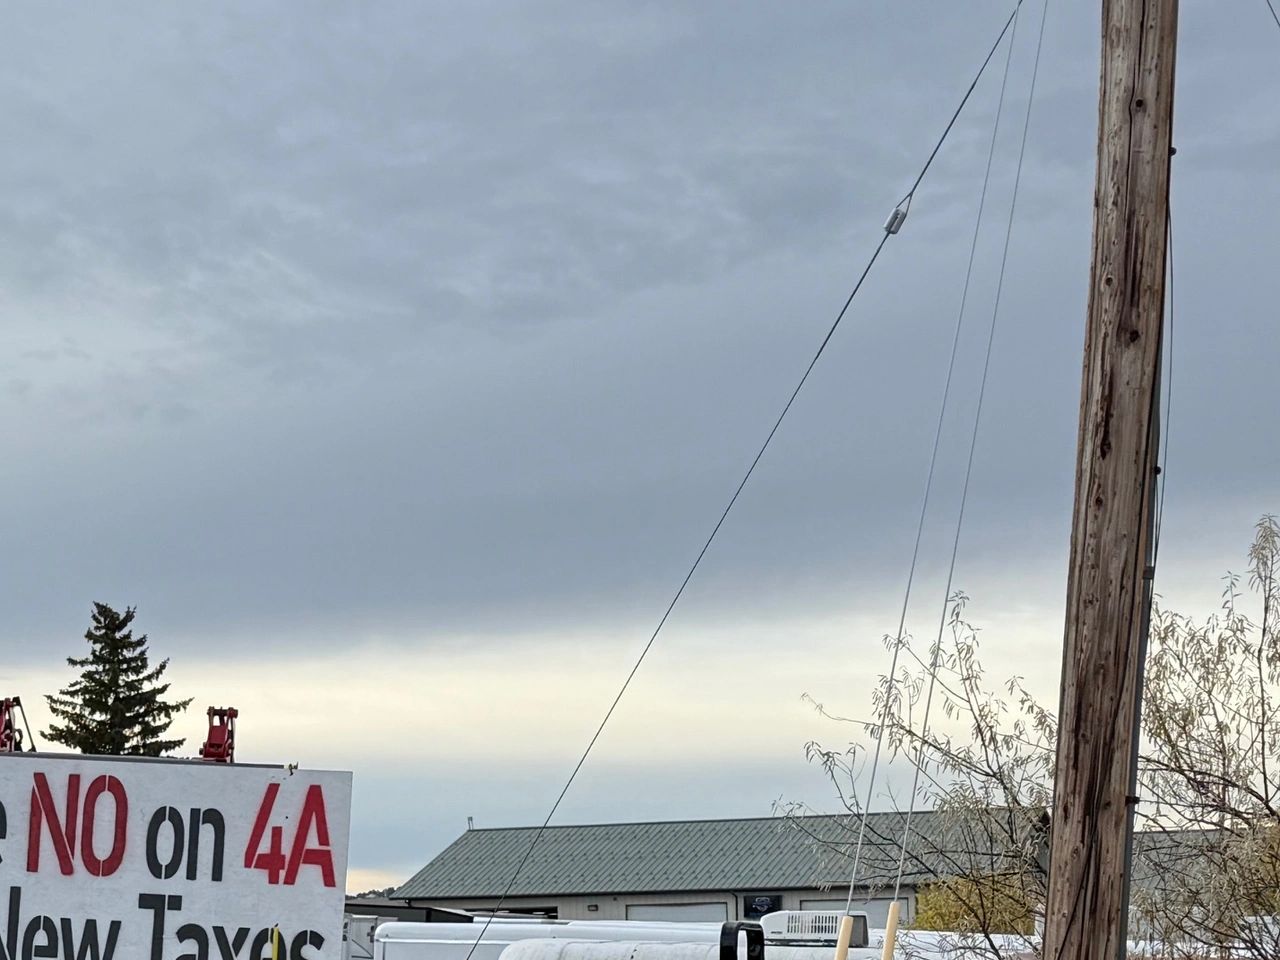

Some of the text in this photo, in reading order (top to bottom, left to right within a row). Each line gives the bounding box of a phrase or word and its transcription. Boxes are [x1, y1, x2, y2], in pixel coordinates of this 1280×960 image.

[26, 771, 129, 877] NO
[145, 805, 226, 882] on
[243, 782, 337, 888] 4A
